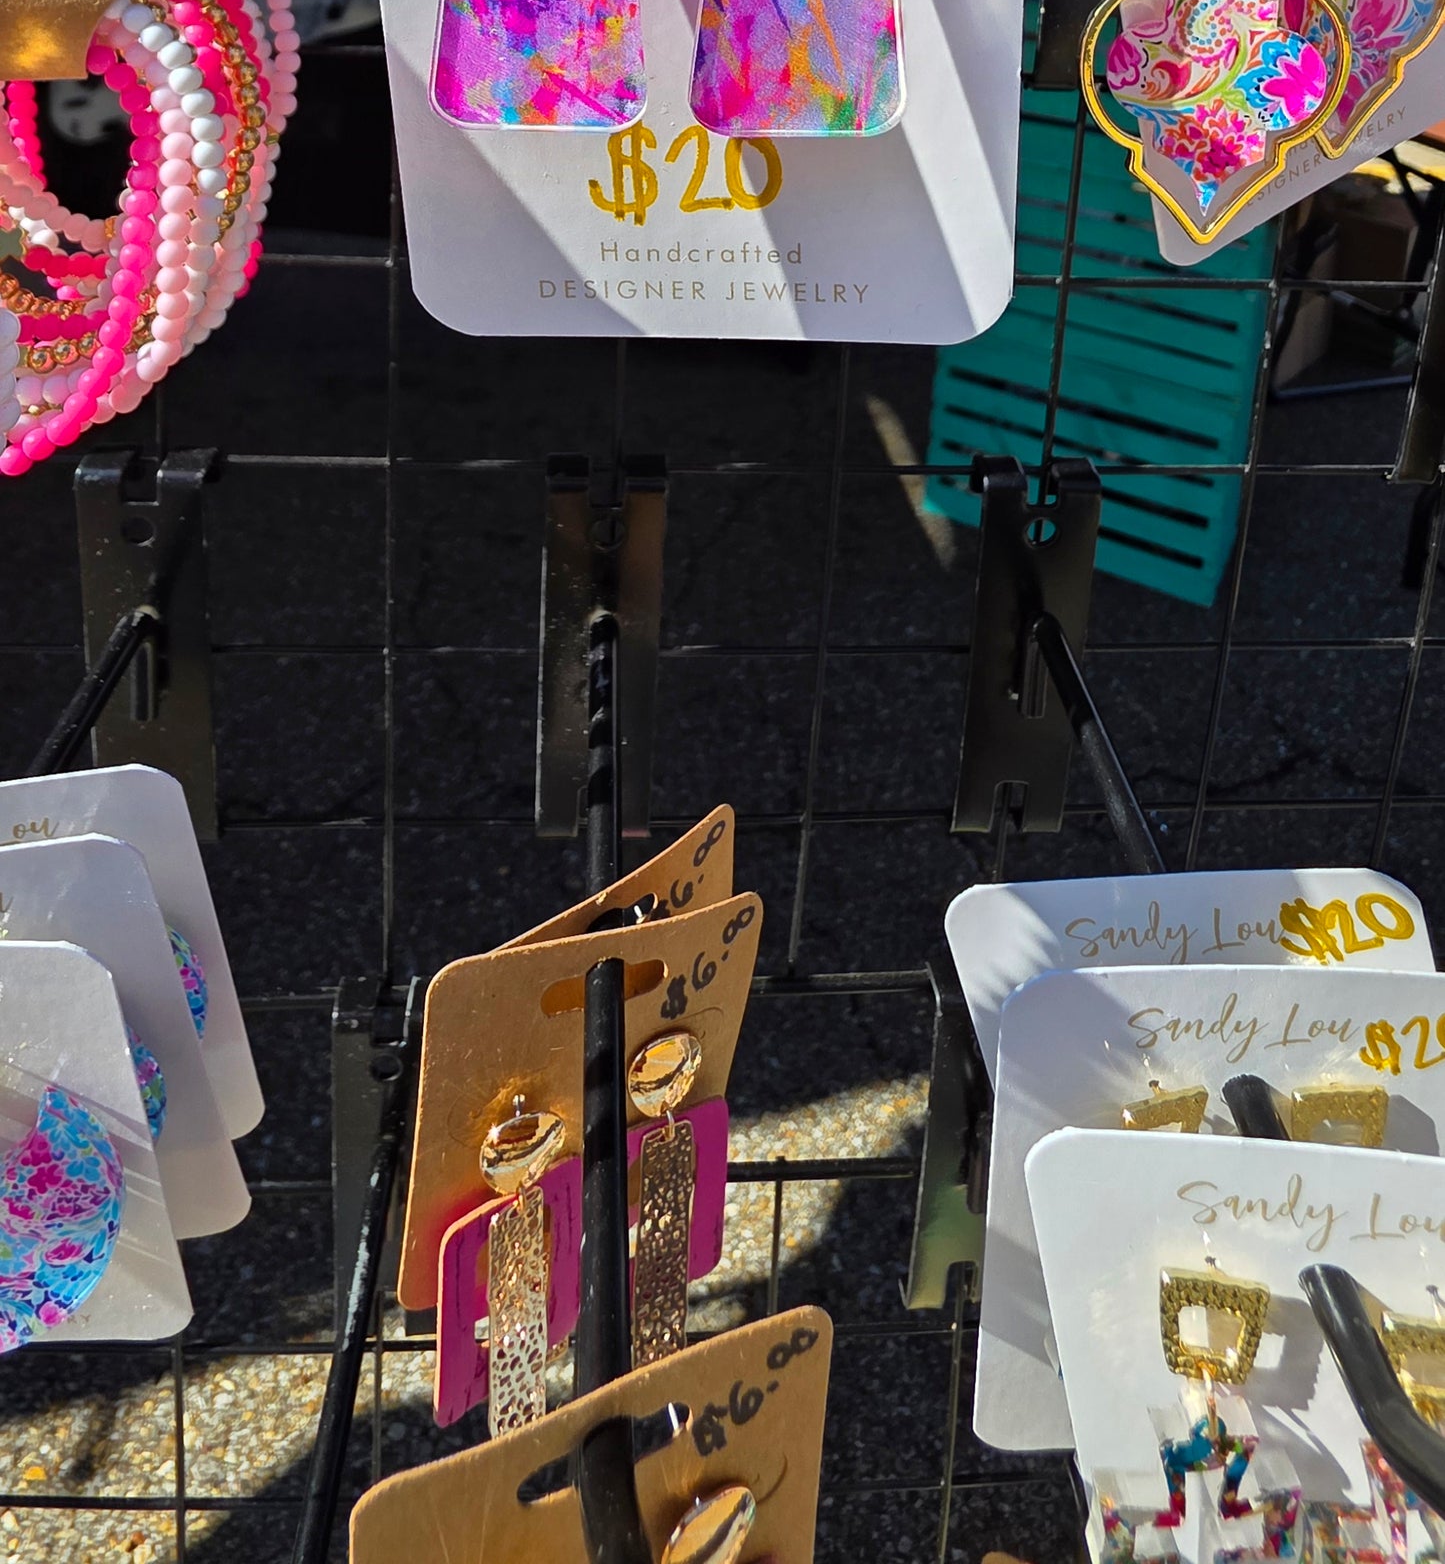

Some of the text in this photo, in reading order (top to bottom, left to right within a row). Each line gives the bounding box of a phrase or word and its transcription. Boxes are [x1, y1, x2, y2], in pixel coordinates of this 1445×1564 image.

[588, 120, 783, 226] $20
[600, 241, 802, 265] Handcrafted
[539, 279, 870, 304] DESIGNER JEWELRY
[1064, 901, 1286, 964] Sandy Lou
[1279, 892, 1415, 965] $20
[1127, 993, 1360, 1063] Sandy Lou
[1176, 1173, 1349, 1253] Sandy
